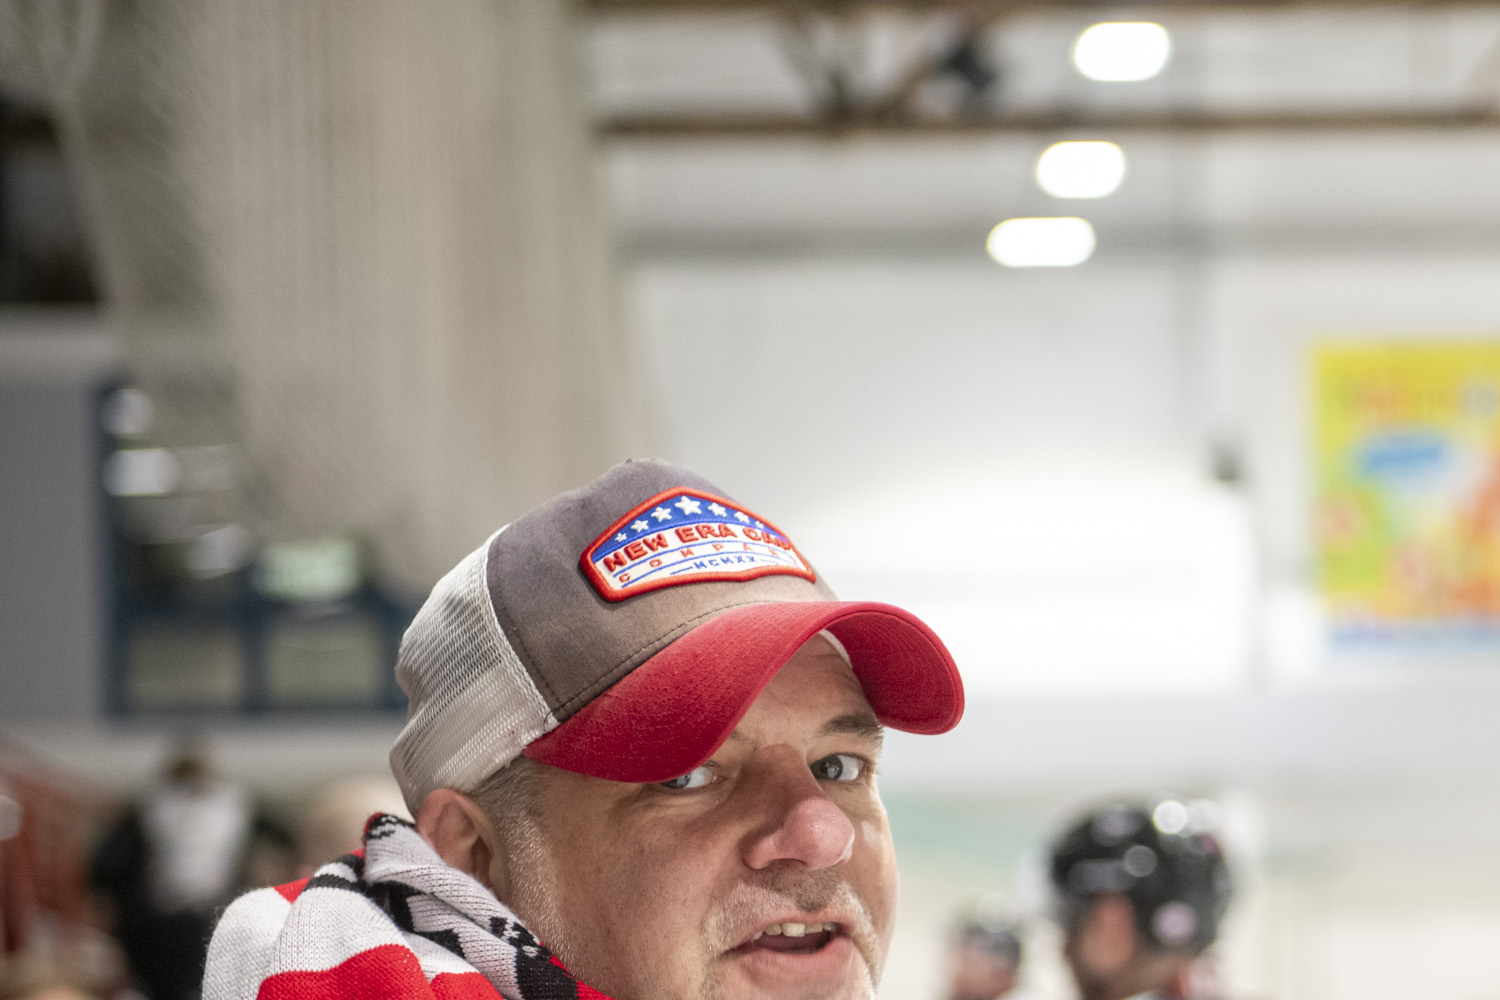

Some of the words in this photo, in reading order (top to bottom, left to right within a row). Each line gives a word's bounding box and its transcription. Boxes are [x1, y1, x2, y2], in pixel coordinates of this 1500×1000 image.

[603, 531, 668, 572] NEW
[675, 523, 738, 544] ERA
[693, 555, 756, 570] MCMXX
